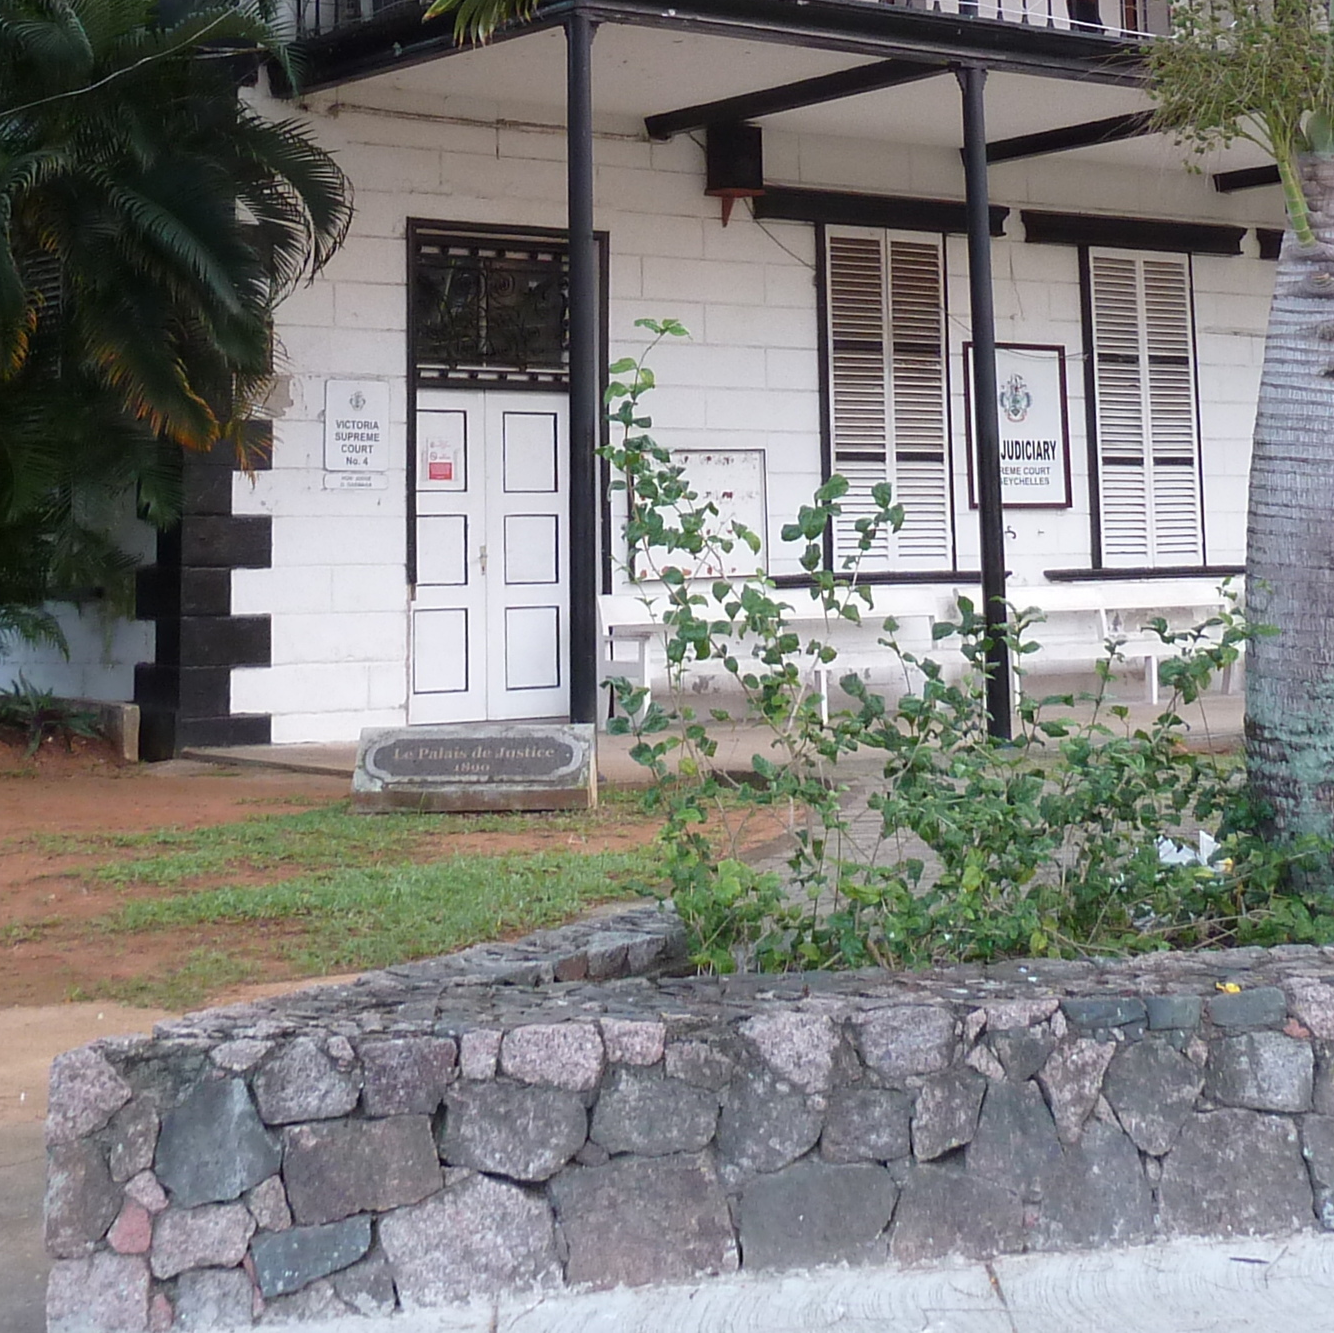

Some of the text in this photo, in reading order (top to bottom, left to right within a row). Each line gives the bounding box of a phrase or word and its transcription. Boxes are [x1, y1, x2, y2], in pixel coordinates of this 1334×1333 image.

[335, 419, 380, 430] VICTORIA
[334, 432, 380, 442] SUPREME
[340, 444, 374, 454] COURT
[1000, 439, 1057, 461] JUDICIARY
[345, 456, 369, 465] No. 4
[1023, 466, 1050, 475] COURT
[392, 745, 555, 760] Le Palais de Justice
